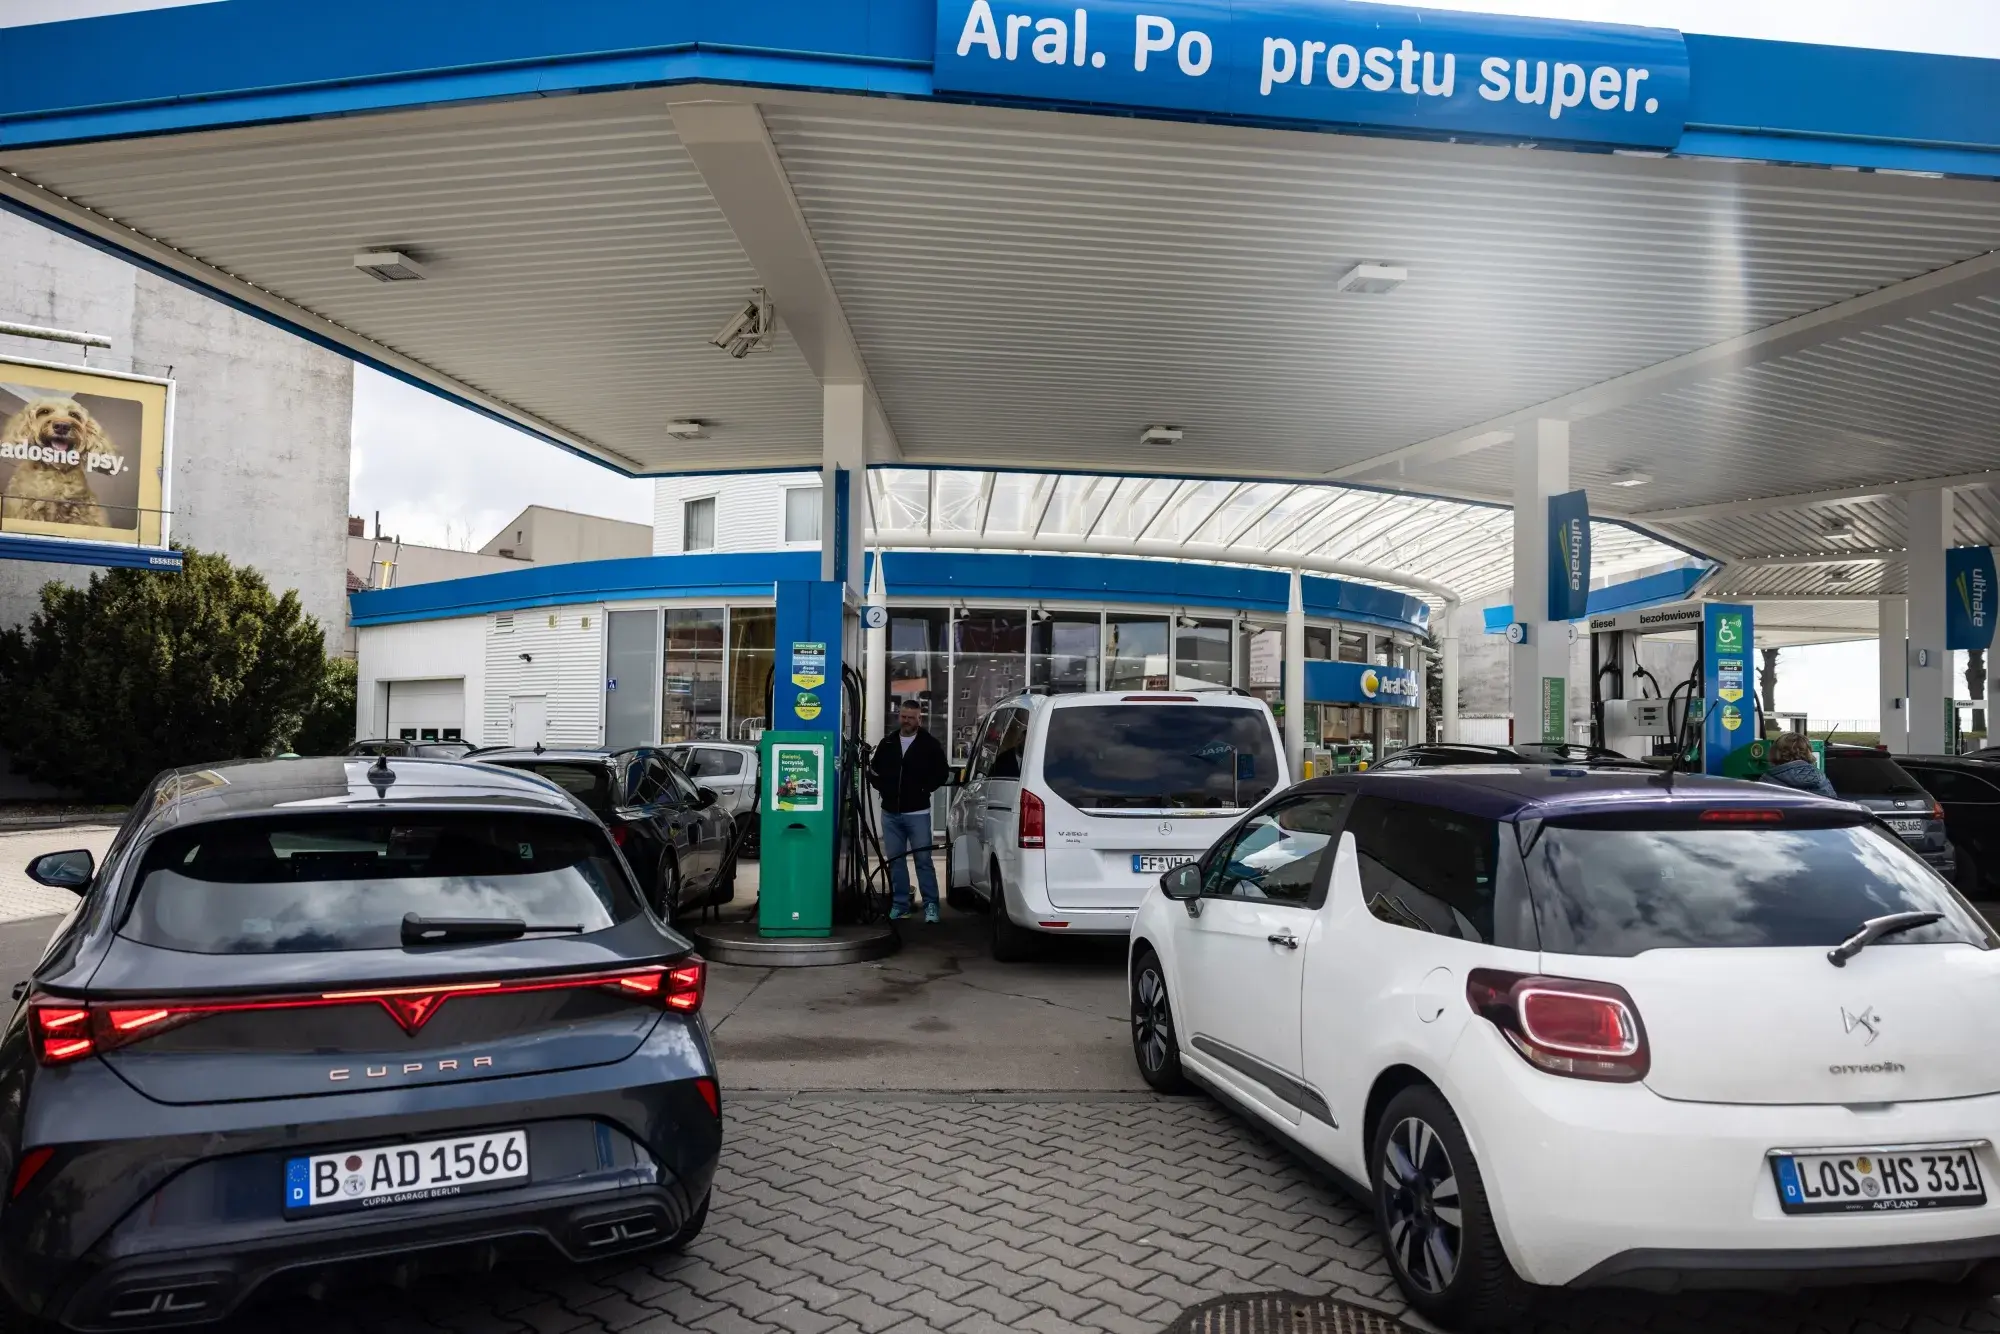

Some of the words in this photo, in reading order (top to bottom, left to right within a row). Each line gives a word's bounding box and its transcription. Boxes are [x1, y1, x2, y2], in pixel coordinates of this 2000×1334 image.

[957, 0, 1106, 69] Aral.
[1135, 15, 1213, 77] Po
[1260, 37, 1456, 98] prostu
[1479, 57, 1659, 120] super.
[0, 440, 79, 465] adosne
[87, 451, 129, 475] psy.
[1572, 519, 1583, 591] ultimate
[1972, 568, 1986, 627] ultimate
[873, 612, 881, 623] 2
[1591, 618, 1616, 629] diesel
[1640, 609, 1701, 624] bezołowiowa
[1511, 627, 1518, 639] 3
[1380, 676, 1400, 695] Aral
[1401, 680, 1419, 698] Store
[1141, 857, 1157, 870] FF
[329, 1055, 493, 1081] CUPRA
[316, 1160, 339, 1198] B
[371, 1150, 420, 1191] AD
[430, 1137, 522, 1183] 1566
[1797, 1159, 1861, 1198] LOS
[1878, 1157, 1919, 1194] HS
[1921, 1154, 1978, 1192] 331
[293, 1188, 303, 1200] D
[363, 1197, 392, 1207] CUPRA
[394, 1190, 429, 1202] GARAGE
[431, 1186, 461, 1198] BERLIN
[1787, 1185, 1796, 1196] D
